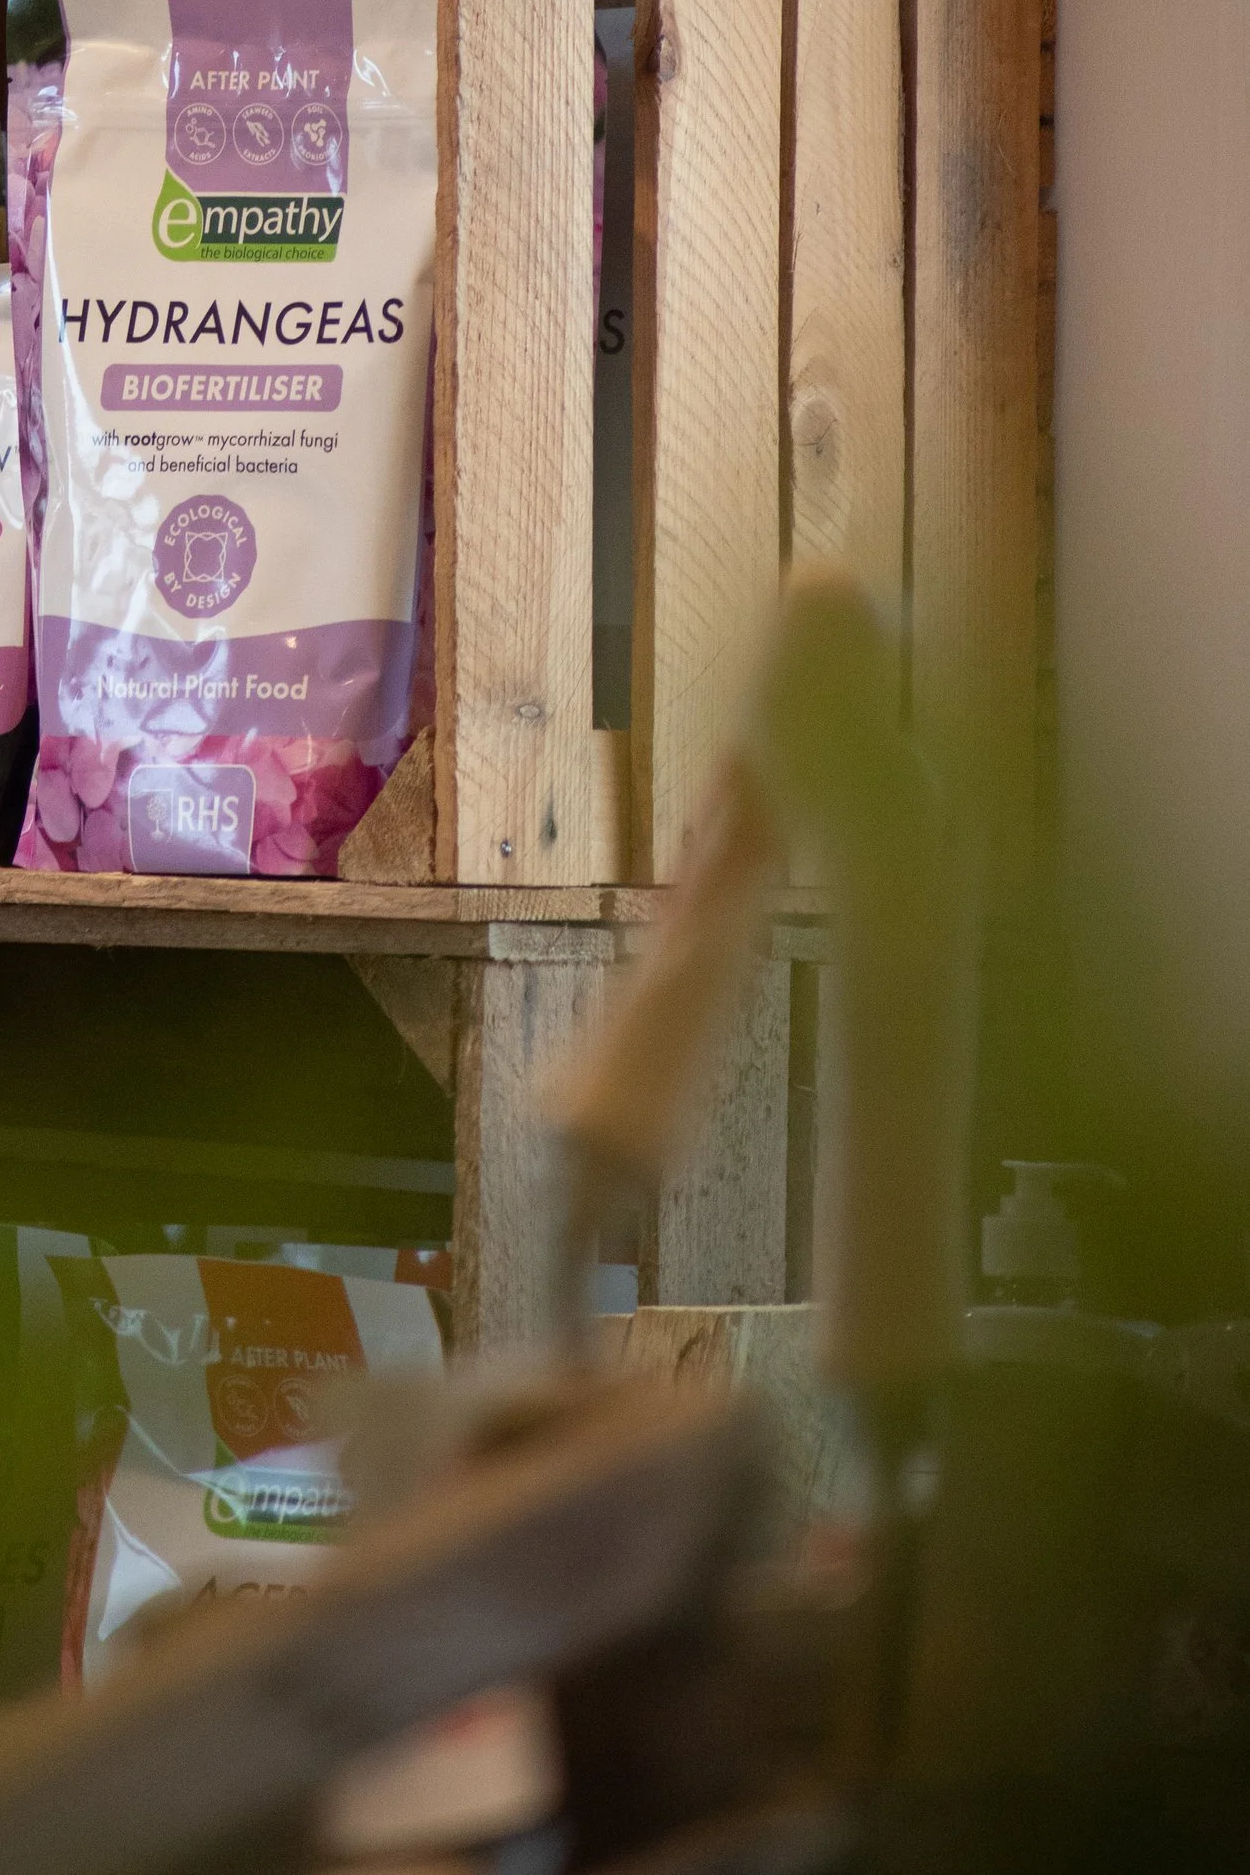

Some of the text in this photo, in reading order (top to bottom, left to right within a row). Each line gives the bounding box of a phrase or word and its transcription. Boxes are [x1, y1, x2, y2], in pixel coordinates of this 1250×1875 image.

[190, 69, 320, 91] AFTER PLANT
[187, 105, 213, 117] AMINO
[241, 108, 274, 121] SEAWEED
[188, 151, 212, 162] ACIDS
[243, 148, 277, 163] EXTRACTS
[298, 143, 337, 161] PROBIOT
[158, 197, 344, 249] empathy
[200, 246, 325, 262] the biological choice
[58, 297, 405, 347] HYDRANGEAS
[122, 374, 323, 402] BIOFERTILISER
[91, 430, 120, 447] with
[207, 429, 296, 452] mycorrhizal
[300, 430, 339, 453] fungi
[128, 456, 298, 474] and beneficial bacteria
[163, 504, 248, 549] ECOLOGICAL
[162, 571, 242, 610] BY DESIGN
[96, 674, 309, 701] Natural Plant Food
[176, 795, 240, 833] RHS
[210, 1472, 341, 1525] empat
